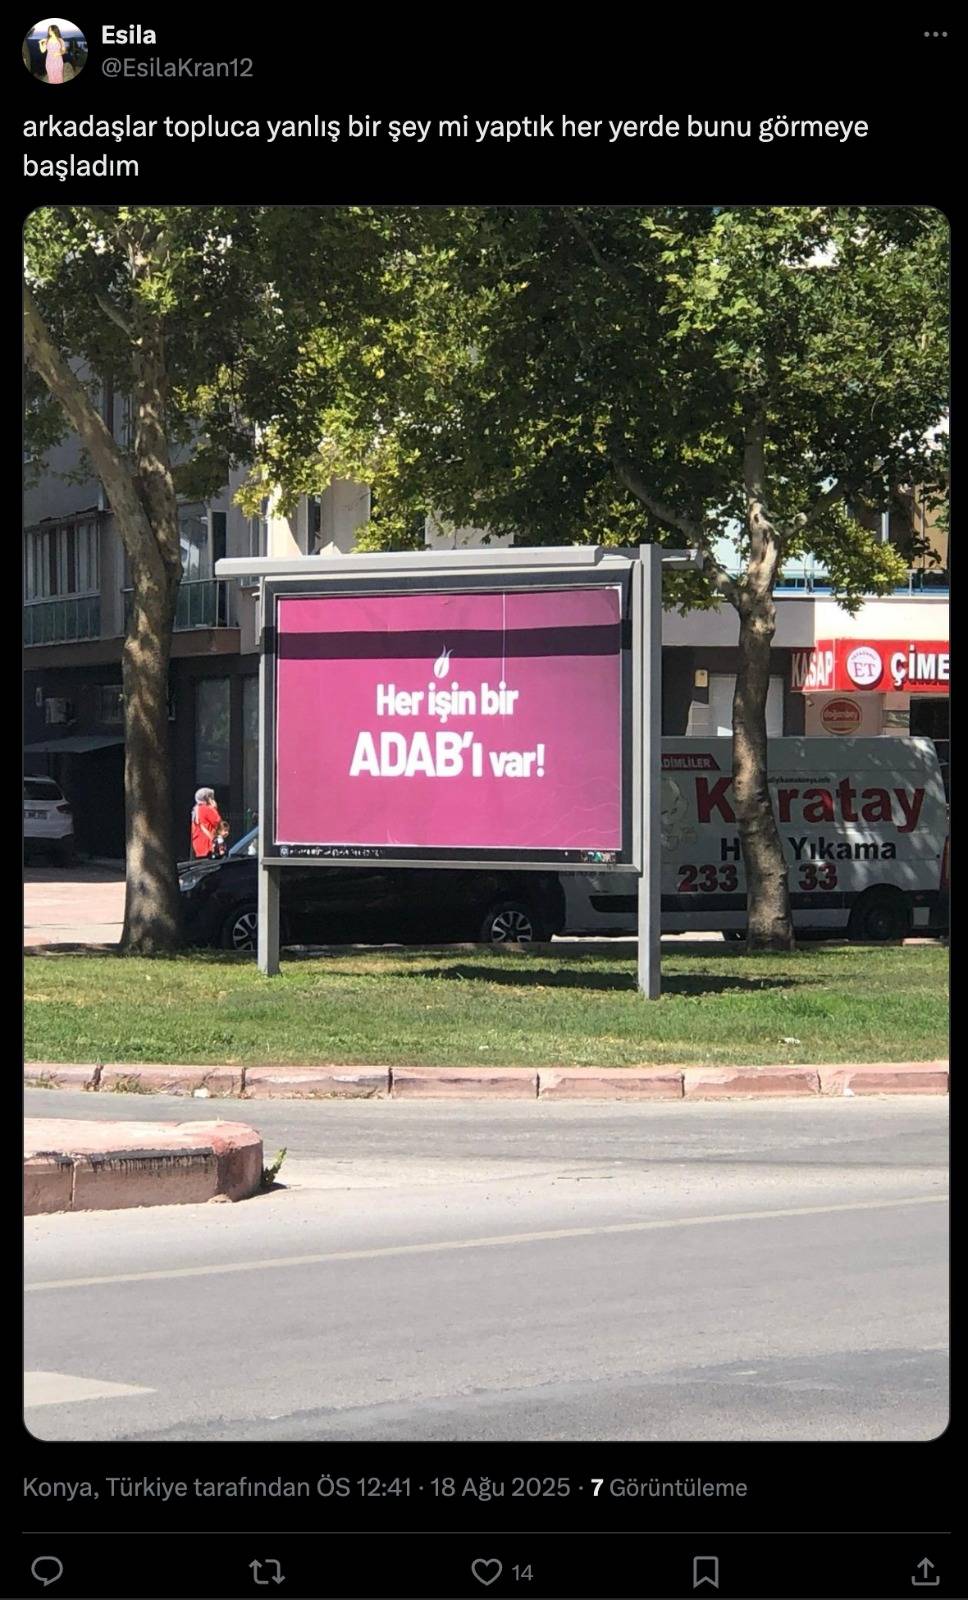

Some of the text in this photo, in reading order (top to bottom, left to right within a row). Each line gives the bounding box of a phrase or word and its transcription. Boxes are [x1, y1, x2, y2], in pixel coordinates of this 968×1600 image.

[791, 651, 834, 688] KASAP
[853, 661, 877, 678] ET
[376, 680, 519, 723] Her işin bir
[489, 743, 545, 777] var!
[695, 776, 926, 834] Kratay
[788, 837, 897, 861] Yıkama
[678, 864, 739, 893] 233
